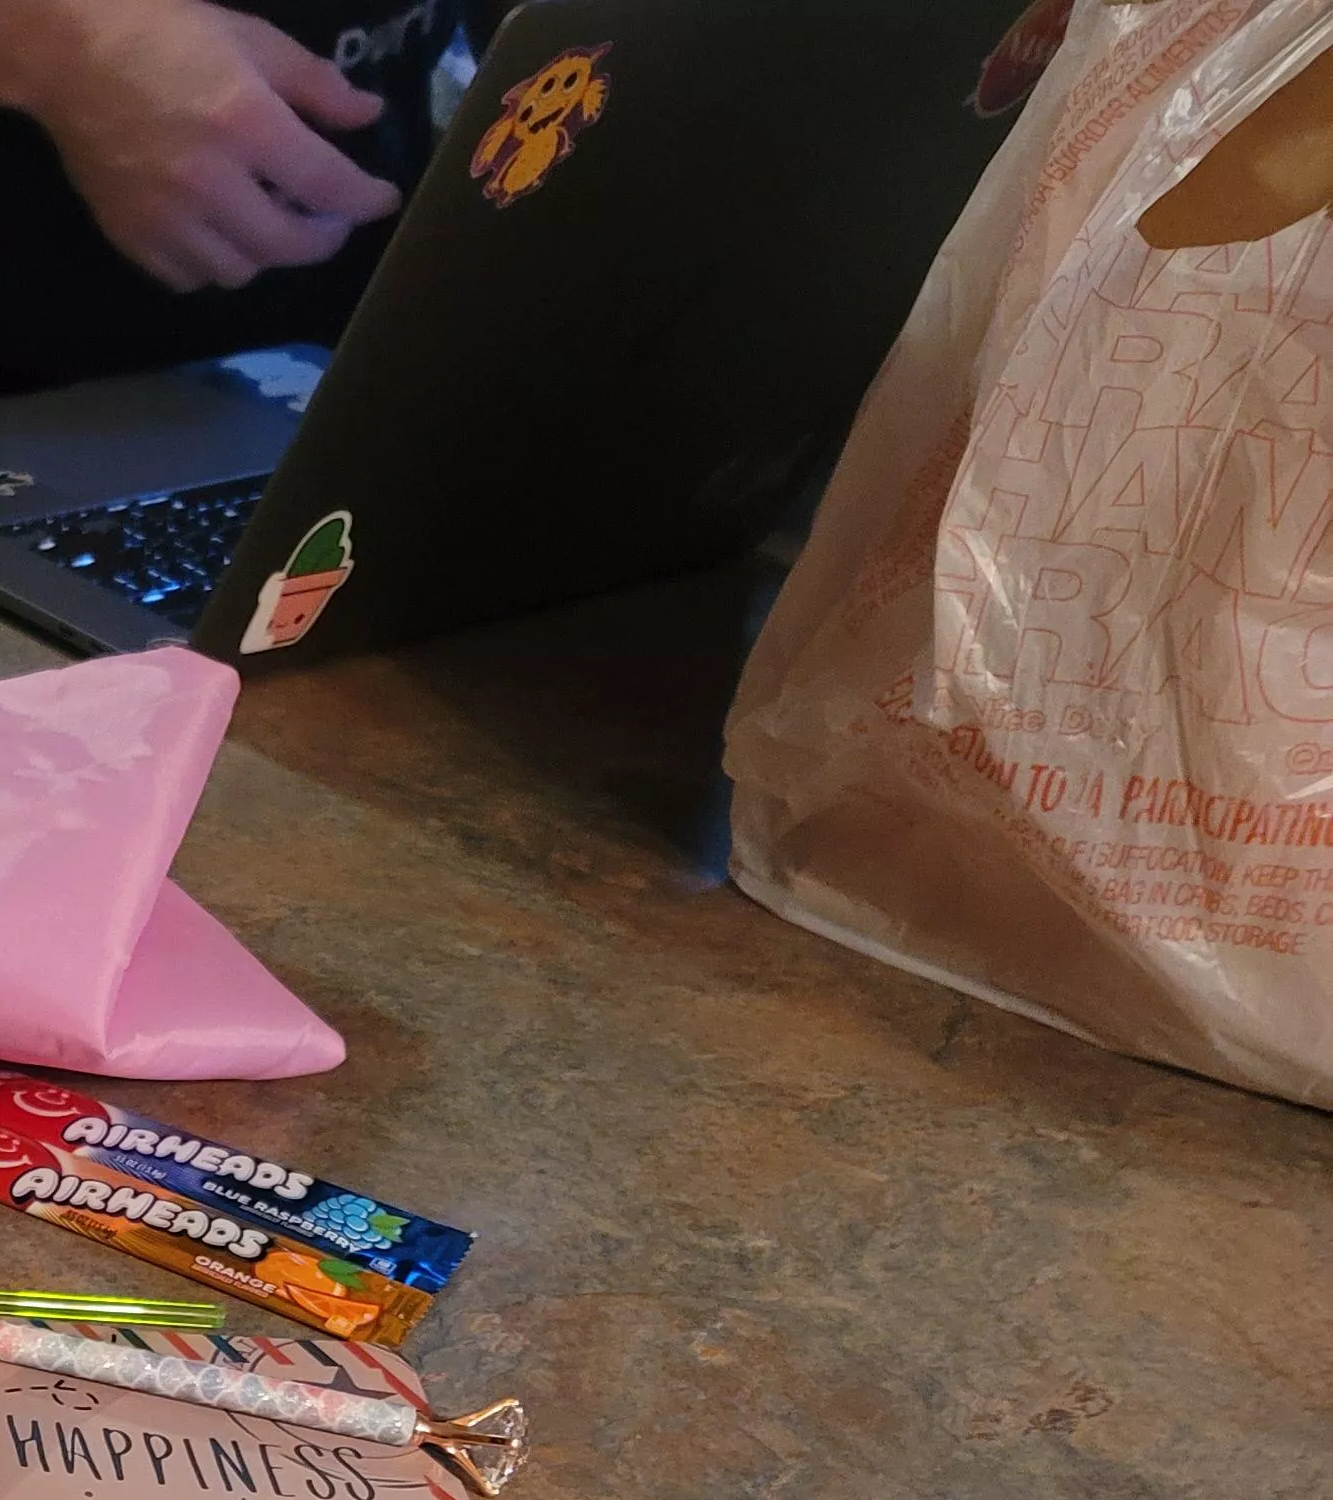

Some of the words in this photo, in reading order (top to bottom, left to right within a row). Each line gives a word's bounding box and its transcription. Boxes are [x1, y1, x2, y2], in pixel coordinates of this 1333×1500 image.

[1023, 764, 1068, 814] TO
[1241, 862, 1299, 889] KEEP
[63, 1117, 315, 1200] AIRHEADS
[11, 1167, 270, 1260] AIRHEADS
[202, 1181, 253, 1207] BLUE
[253, 1199, 362, 1253] RASPBERRY
[193, 1254, 278, 1294] ORANGE
